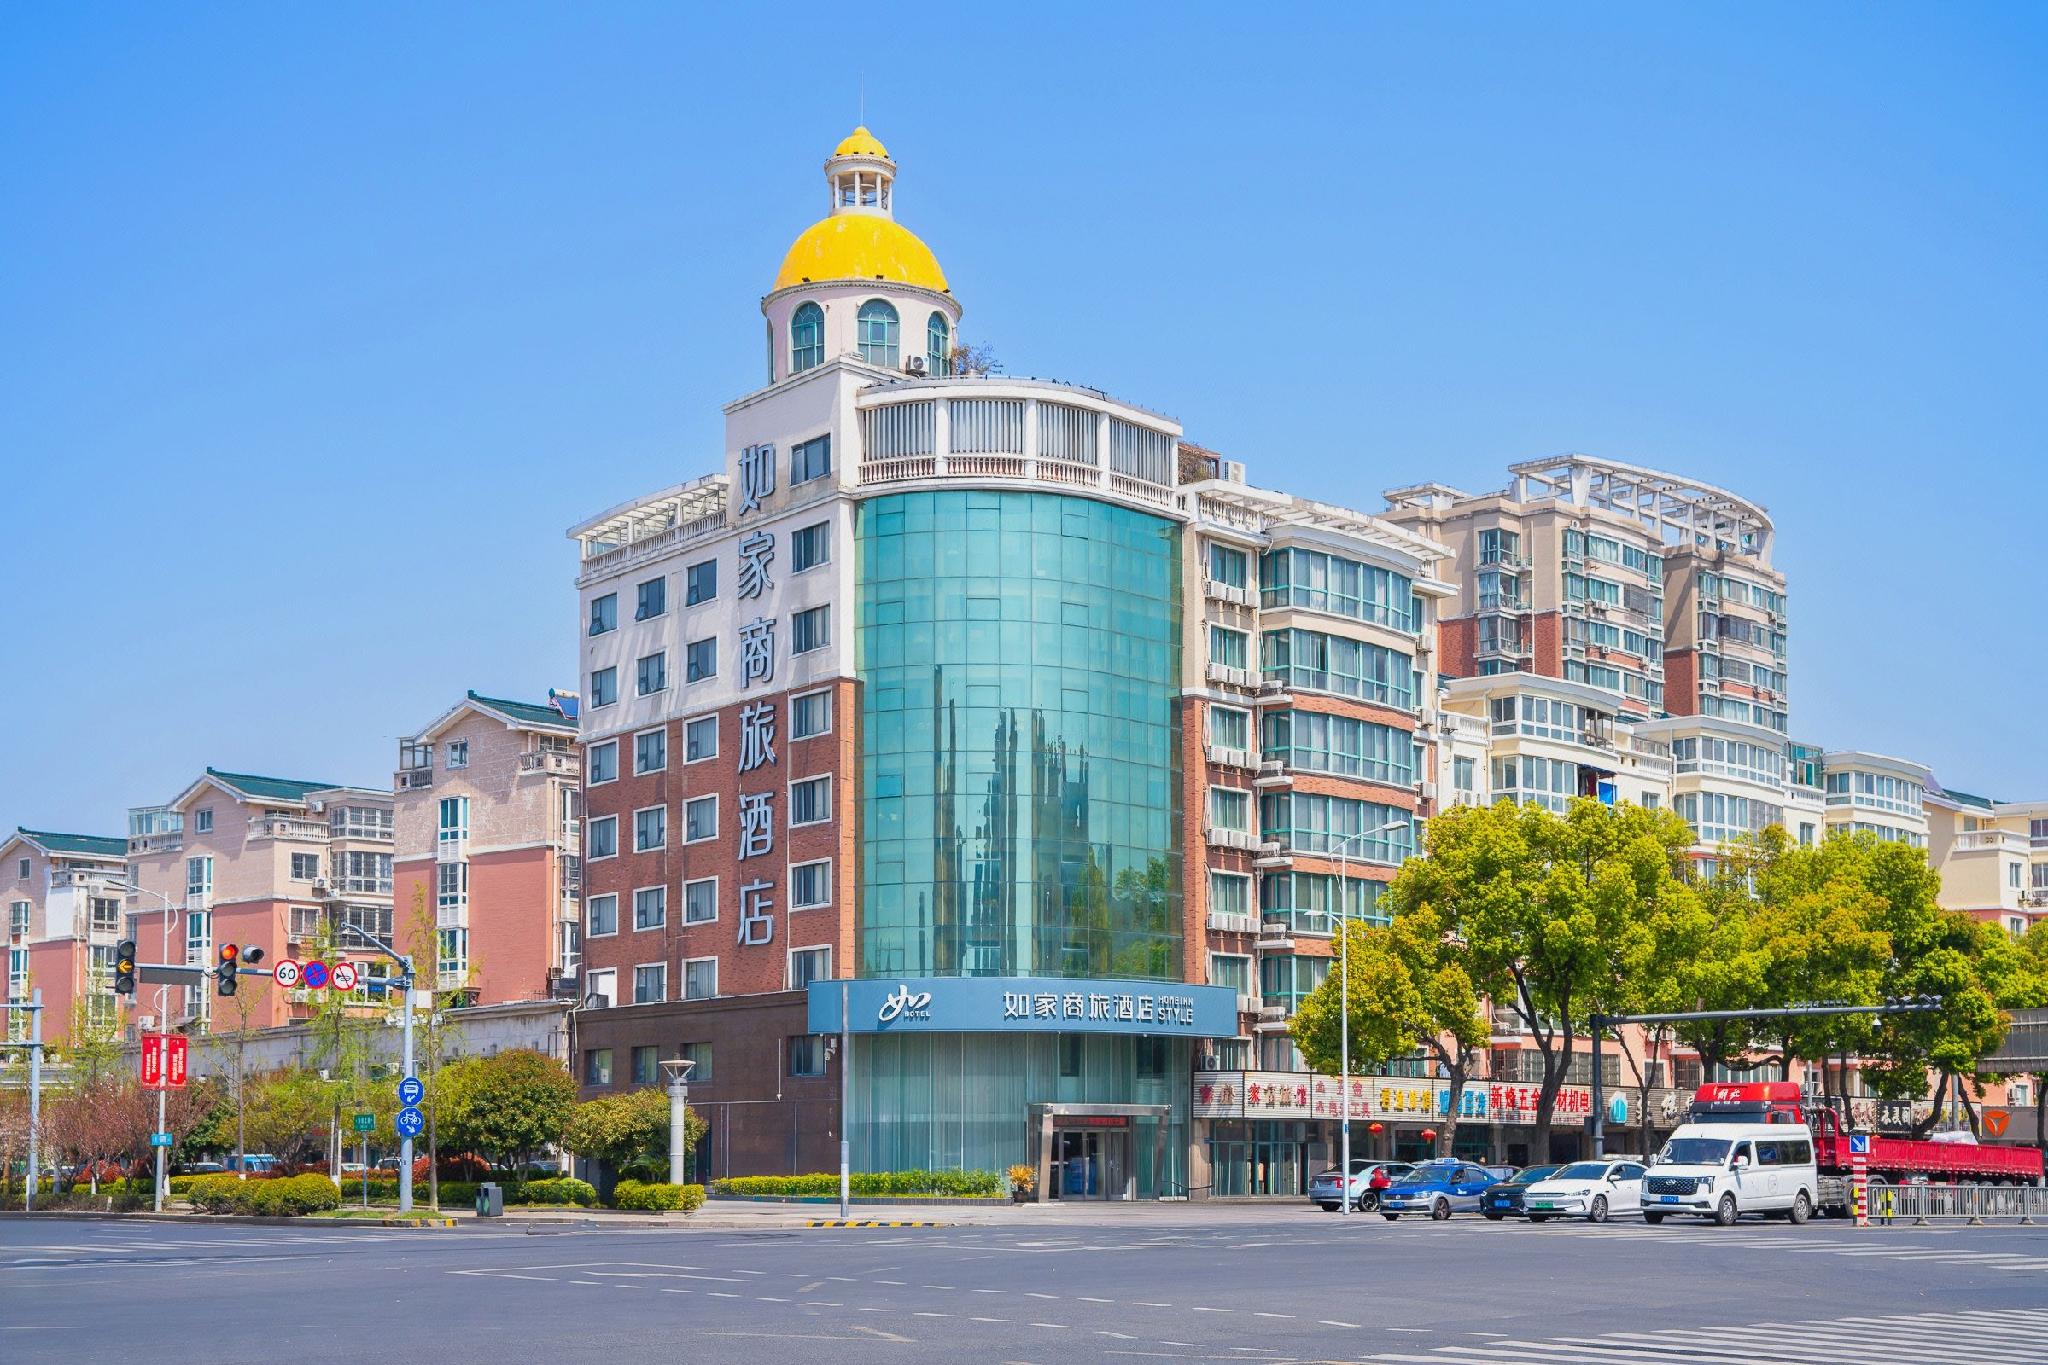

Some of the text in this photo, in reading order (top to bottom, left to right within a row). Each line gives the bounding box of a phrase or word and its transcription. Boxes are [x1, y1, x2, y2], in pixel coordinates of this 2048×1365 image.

[738, 443, 776, 946] 如家商旅酒店
[279, 967, 295, 980] 60
[1003, 991, 1153, 1021] 如家商旅酒店
[1158, 1007, 1194, 1023] STYLE
